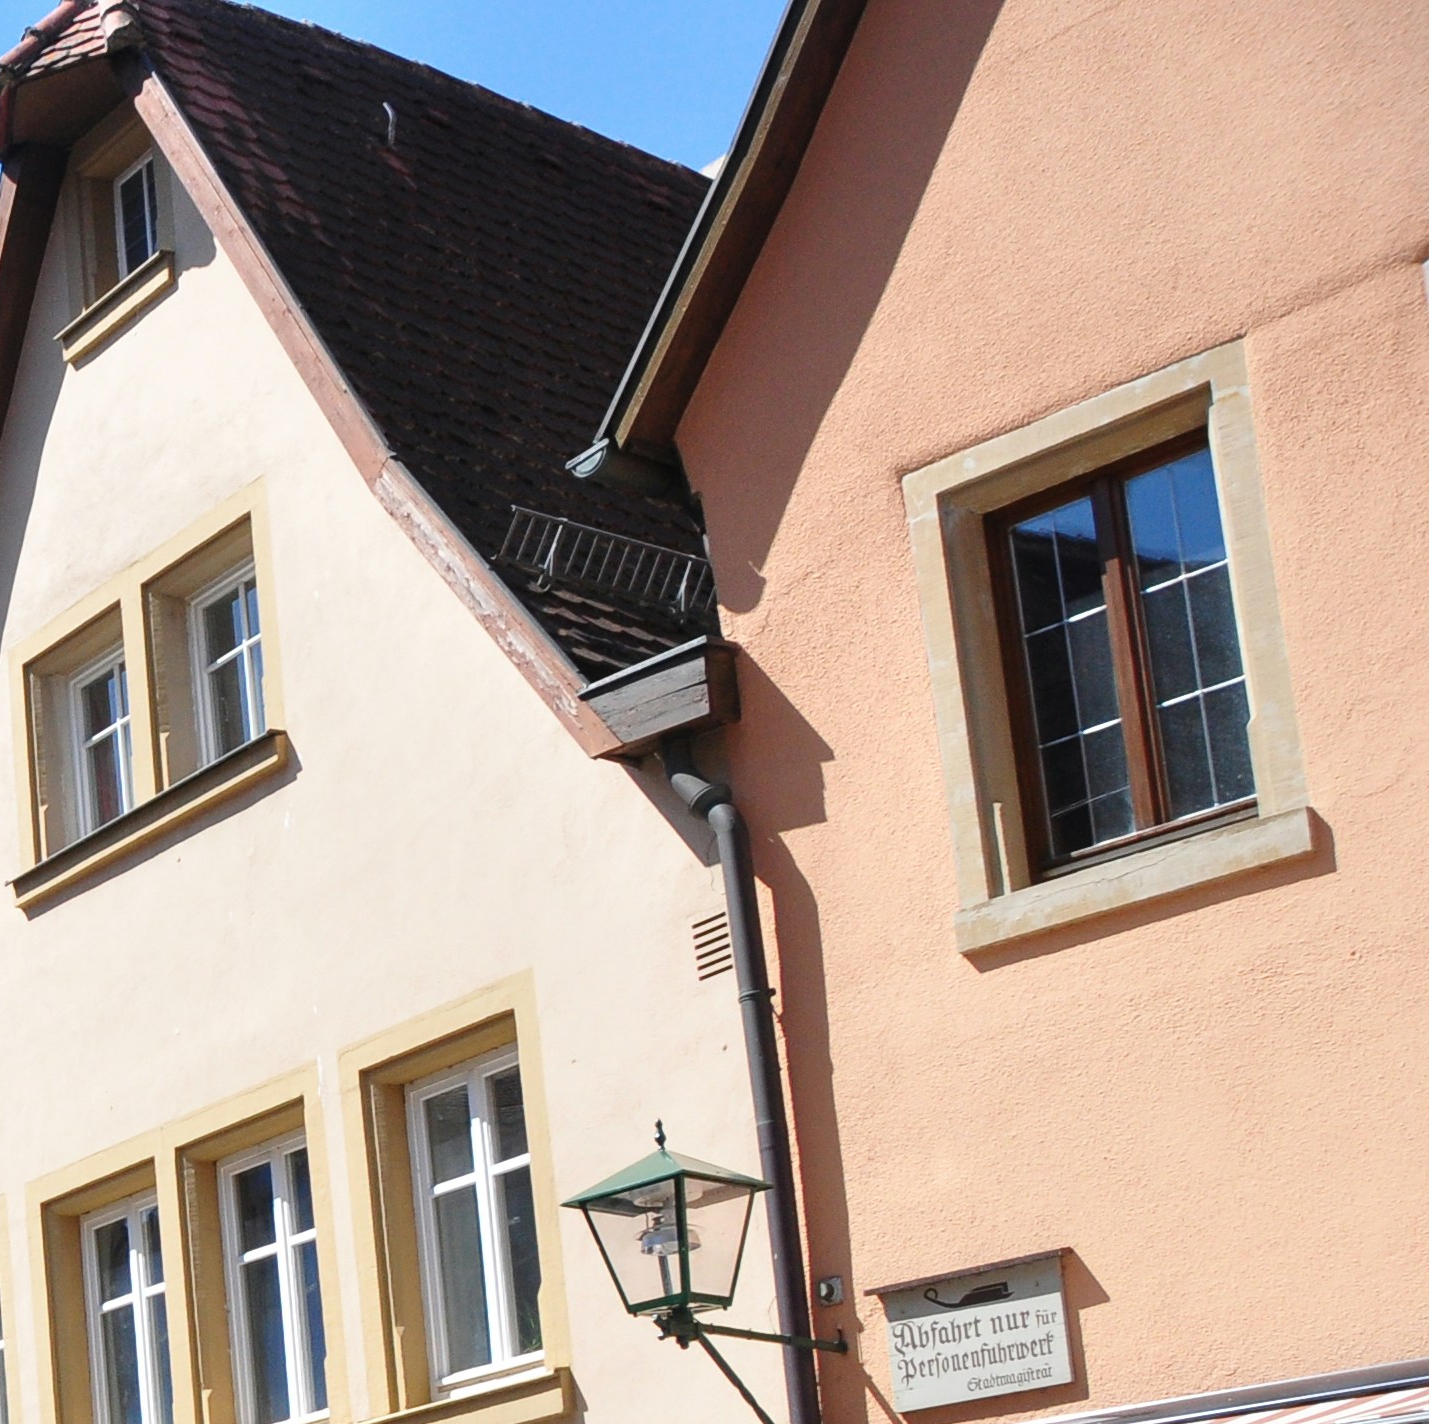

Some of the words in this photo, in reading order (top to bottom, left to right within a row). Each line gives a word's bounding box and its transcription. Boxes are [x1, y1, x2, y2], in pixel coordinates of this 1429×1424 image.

[892, 1315, 982, 1357] Abfahrt
[990, 1309, 1030, 1335] nur
[1035, 1309, 1057, 1328] für
